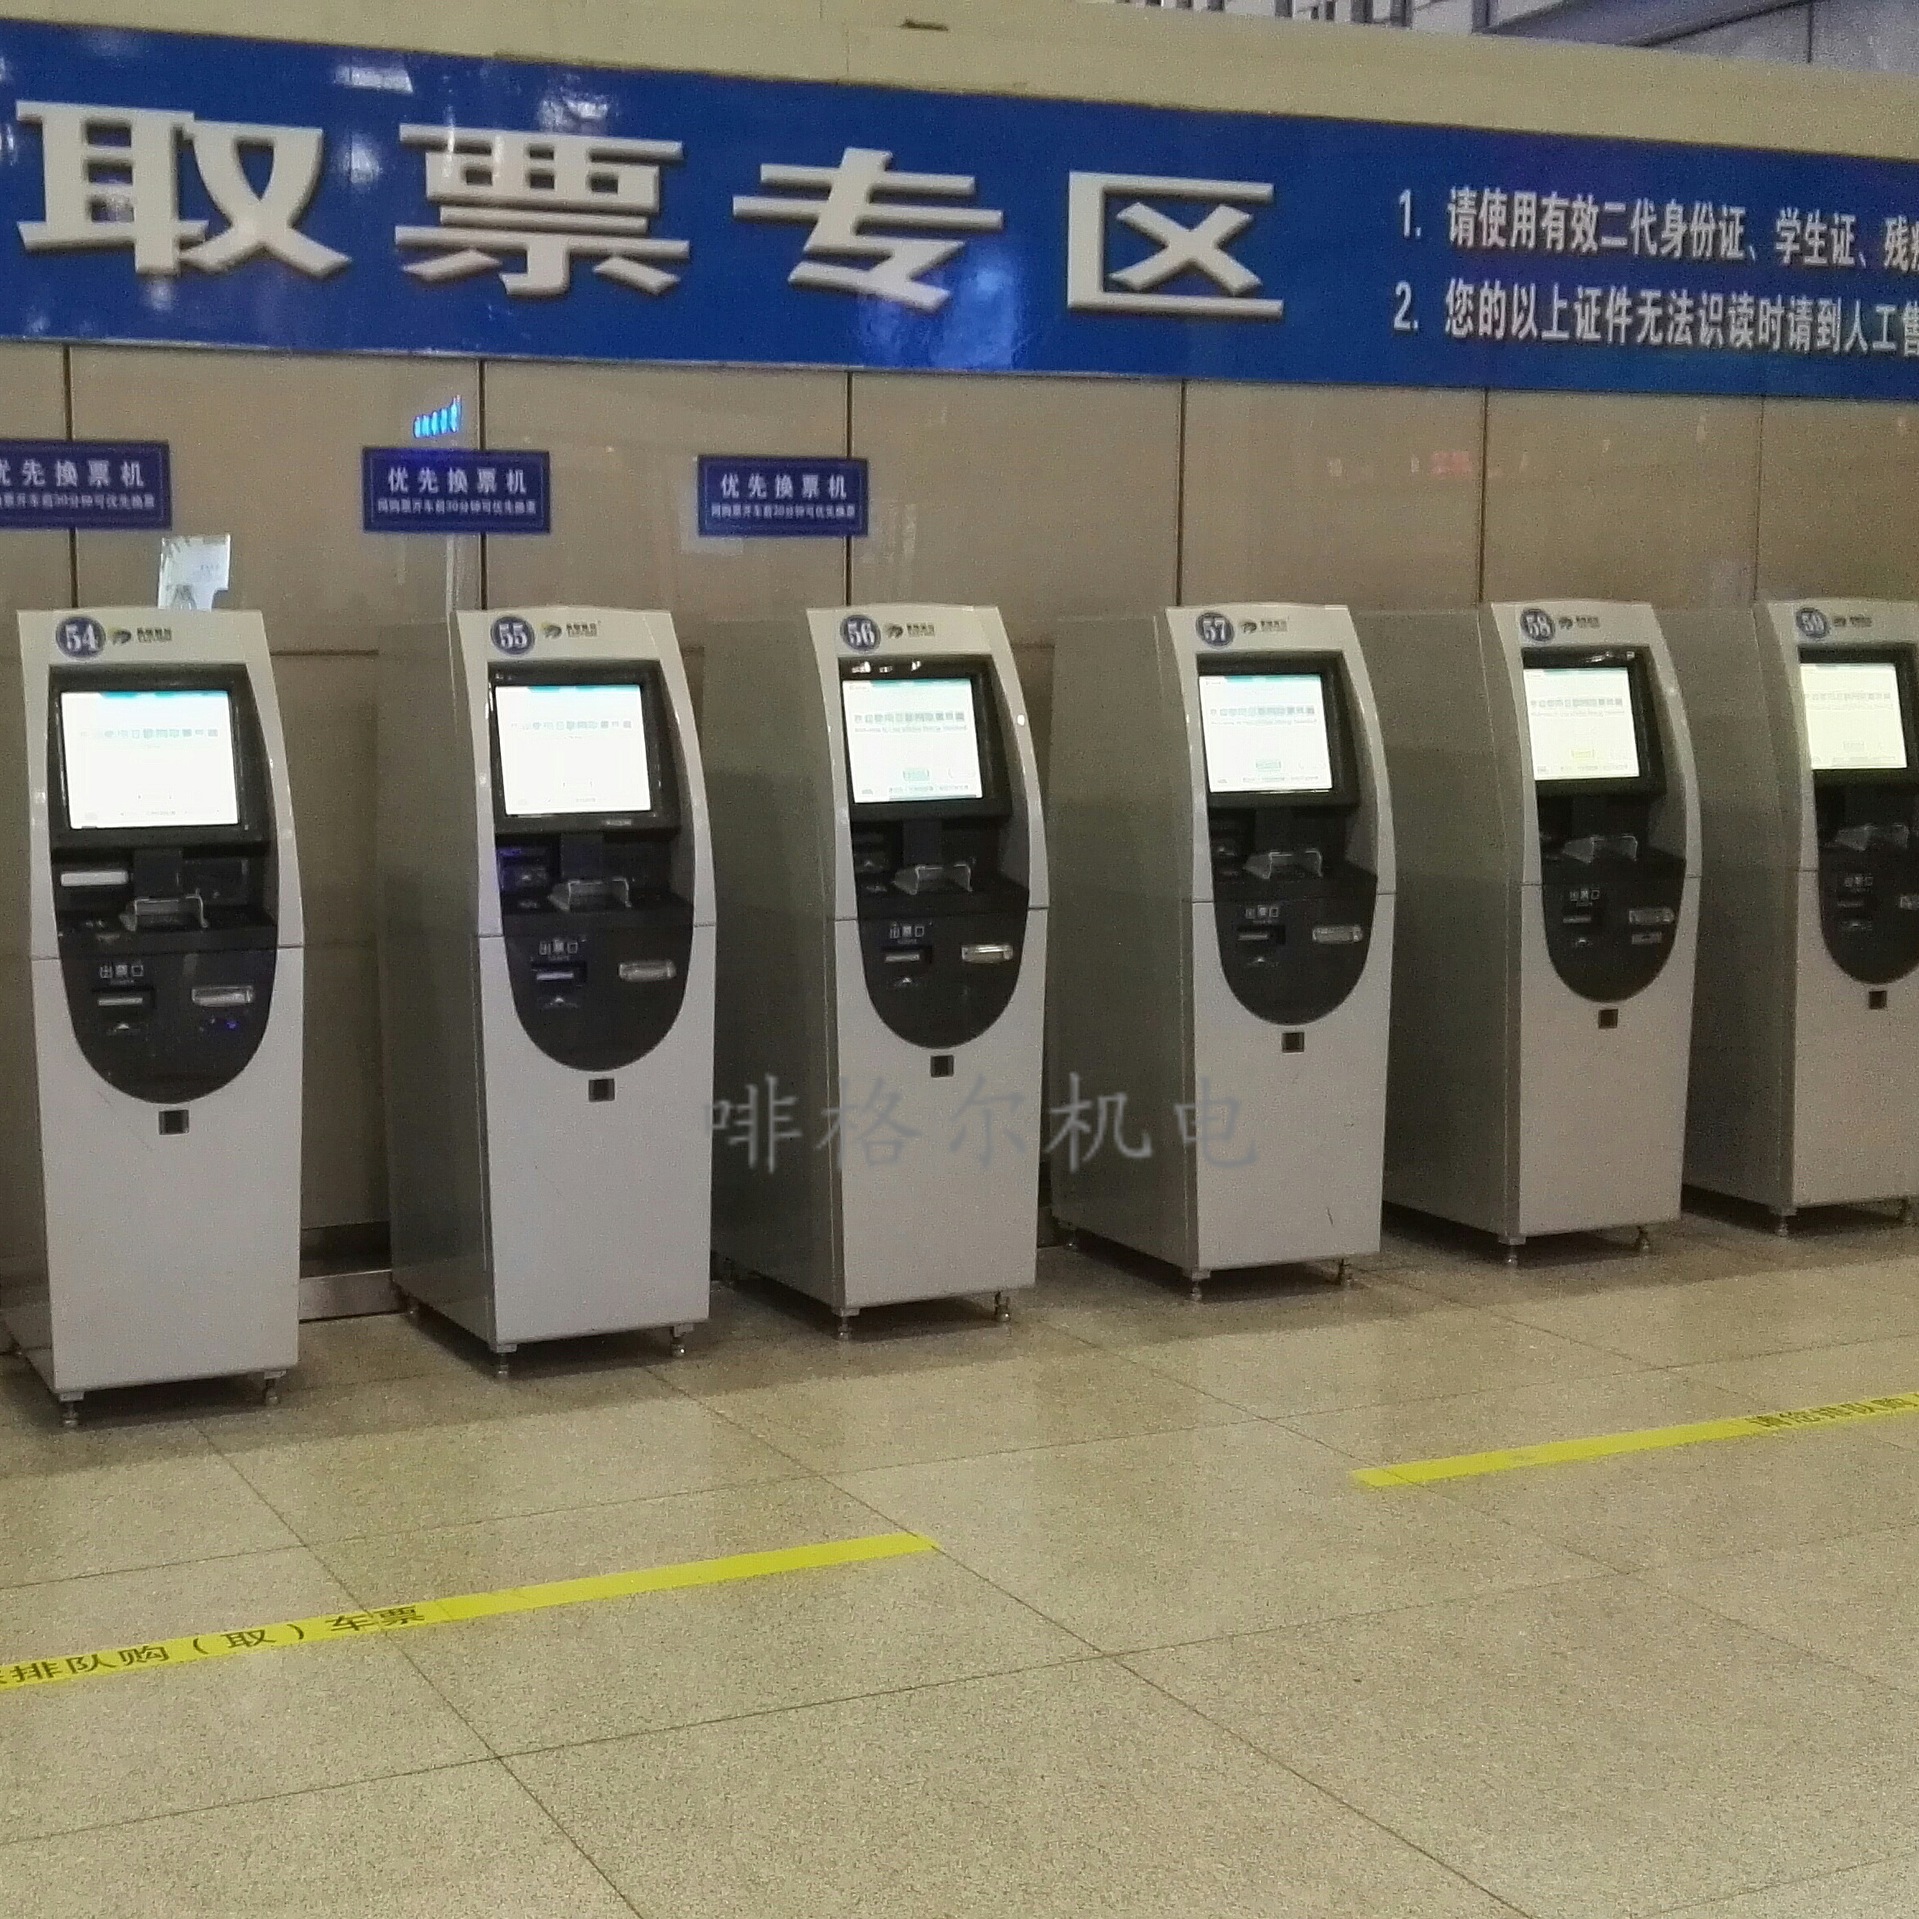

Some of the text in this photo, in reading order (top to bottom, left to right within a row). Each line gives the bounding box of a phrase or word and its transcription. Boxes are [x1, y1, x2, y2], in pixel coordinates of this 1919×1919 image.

[16, 100, 1284, 320] 取票专区
[1399, 188, 1422, 239] 1.
[1393, 280, 1419, 332] 2.
[387, 466, 527, 495] 优先换票机
[721, 472, 847, 499] 优先换票机
[65, 623, 99, 651] 54
[498, 622, 528, 649] 55
[847, 620, 875, 647] 56
[1202, 617, 1227, 642] 57
